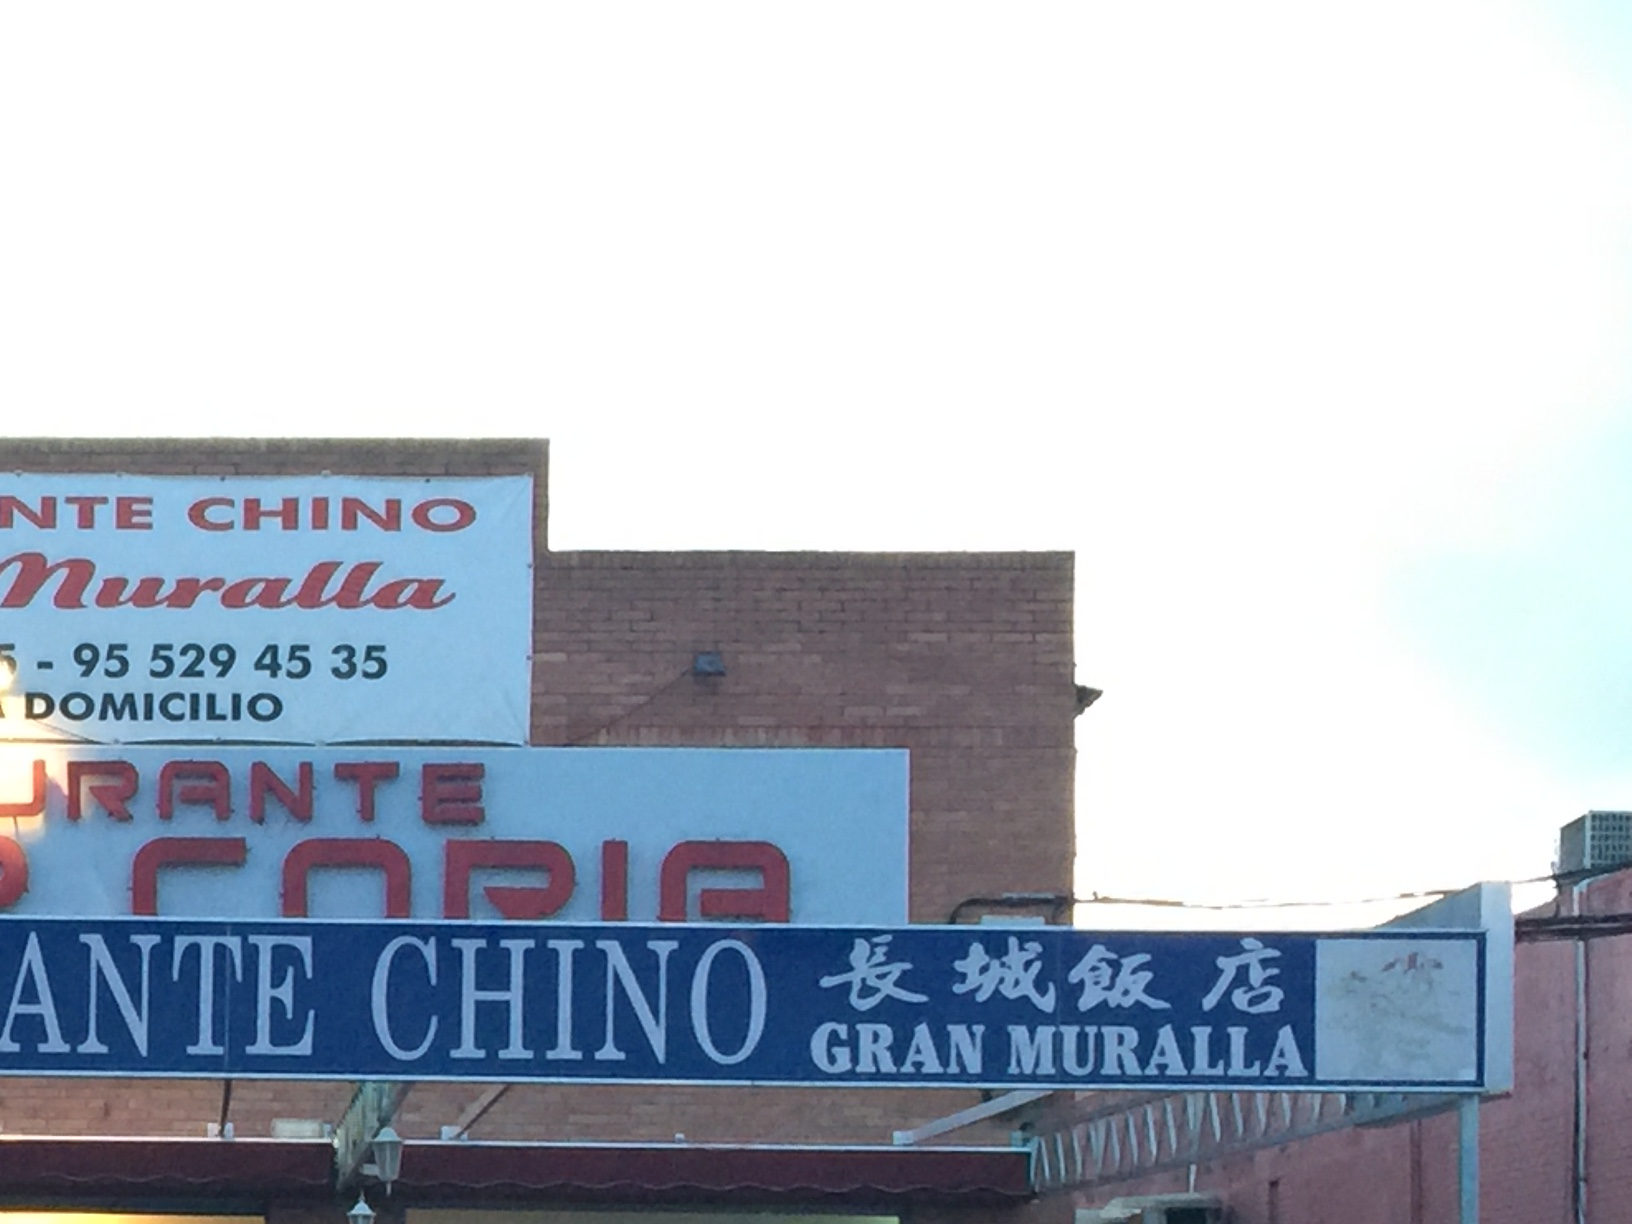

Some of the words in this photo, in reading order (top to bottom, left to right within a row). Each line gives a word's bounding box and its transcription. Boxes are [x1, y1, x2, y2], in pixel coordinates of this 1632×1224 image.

[187, 496, 475, 532] CHINO
[72, 642, 131, 680] 95
[148, 643, 238, 680] 529
[252, 643, 313, 680] 45
[330, 643, 389, 681] 35
[24, 691, 285, 722] DOMICILIO
[818, 934, 1286, 1014] 長城飯店
[372, 935, 767, 1066] CHINO
[809, 1021, 986, 1077] GRAN
[1006, 1023, 1310, 1080] MURALLA
